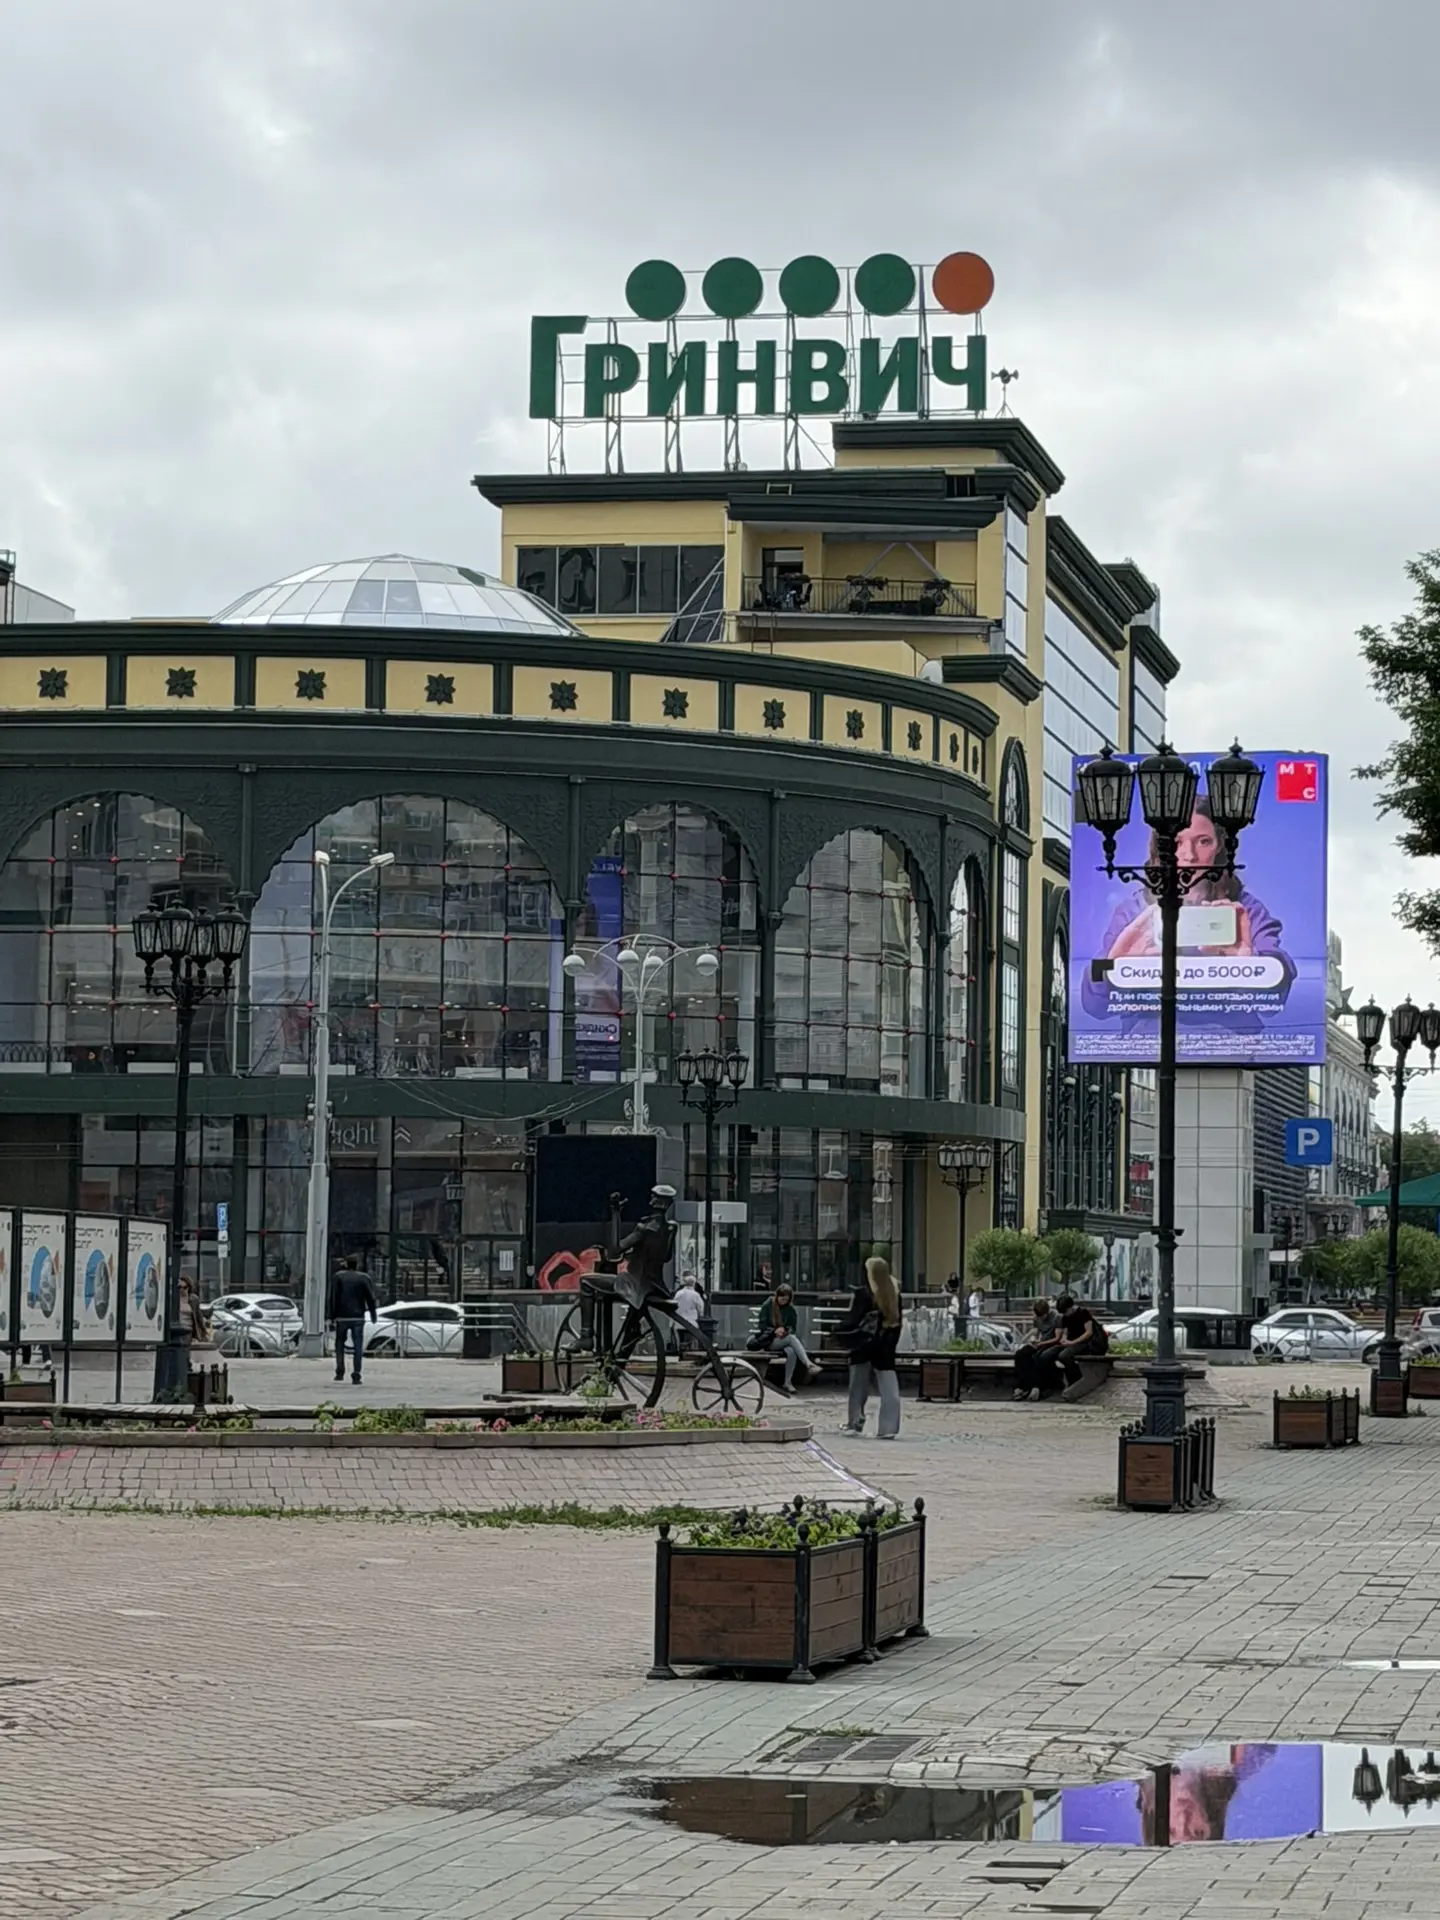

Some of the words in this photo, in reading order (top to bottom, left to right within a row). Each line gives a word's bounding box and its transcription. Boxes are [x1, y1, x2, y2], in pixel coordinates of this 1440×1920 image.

[1120, 965, 1181, 980] Скид
[1183, 967, 1204, 980] до
[1109, 991, 1135, 1002] При
[1255, 992, 1280, 1001] или
[1107, 1003, 1222, 1012] дополнильными
[1224, 1003, 1284, 1014] услугами
[1297, 1128, 1320, 1156] P
